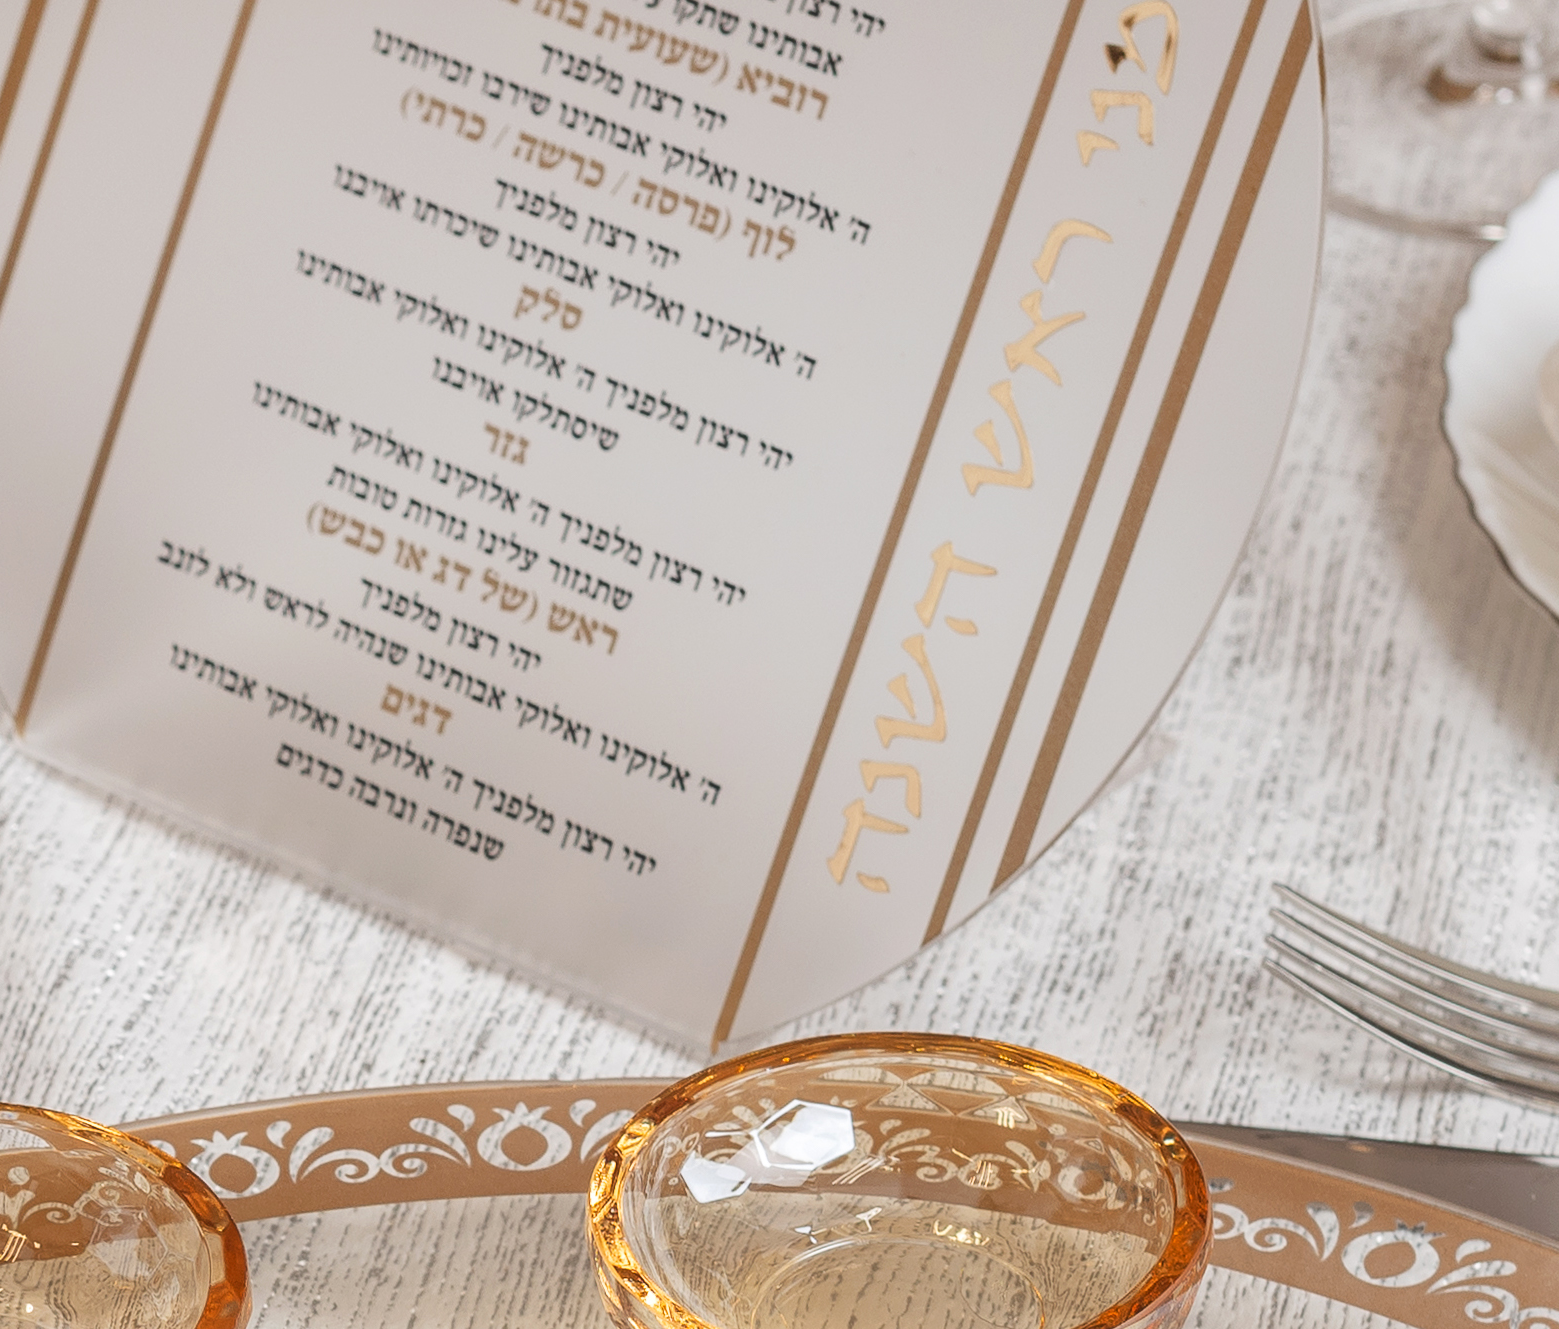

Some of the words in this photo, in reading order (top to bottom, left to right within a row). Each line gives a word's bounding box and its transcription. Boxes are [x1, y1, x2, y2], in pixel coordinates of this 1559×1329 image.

[849, 7, 887, 38] יהי
[373, 28, 475, 86] זכויותינו
[541, 43, 624, 96] מלפניך
[748, 20, 845, 77] אבותינו
[400, 89, 487, 142] כרתי)
[482, 71, 552, 116] שירבו
[630, 79, 684, 118] רצון
[693, 103, 727, 132] יהי
[735, 62, 831, 122] רוביא
[559, 102, 651, 157] אבותינו
[512, 131, 606, 189] כרשה
[660, 141, 738, 192] ואלוקי
[335, 164, 406, 211] אויבנו
[496, 178, 578, 232] מלפניך
[632, 177, 731, 239] (פרסה
[747, 176, 840, 233] אלוקינו
[413, 196, 500, 248] שיכרתו
[584, 215, 637, 254] רצון
[742, 218, 796, 261] לוף
[297, 249, 386, 304] אבותינו
[507, 235, 599, 290] אבותינו
[647, 239, 681, 268] יהי
[395, 289, 469, 339] ואלוקי
[514, 285, 583, 331] סלק
[608, 275, 685, 326] ואלוקי
[477, 324, 567, 380] אלוקינו
[693, 310, 786, 367] אלוקינו
[961, 218, 1113, 497] ראש
[433, 356, 505, 405] אויבנו
[606, 377, 689, 432] מלפניך
[253, 381, 341, 436] אבותינו
[513, 390, 619, 451] שיסתלקו
[350, 422, 424, 472] ואלוקי
[484, 423, 530, 465] גזר
[696, 416, 749, 456] רצון
[759, 440, 793, 470] יהי
[326, 465, 398, 511] טובות
[432, 457, 521, 513] אלוקינו
[307, 502, 386, 556] כבש)
[402, 497, 468, 542] גזרות
[560, 511, 643, 567] מלפניך
[157, 540, 211, 577] לזנב
[394, 538, 428, 573] או
[432, 556, 473, 592] דג
[477, 527, 539, 572] עלינו
[649, 551, 703, 591] רצון
[215, 565, 257, 600] ולא
[264, 586, 330, 629] לראש
[361, 578, 442, 632] מלפניך
[481, 568, 539, 623] (של
[549, 557, 633, 611] שתגזור
[713, 576, 746, 606] יהי
[334, 618, 409, 666] שנהיה
[447, 617, 499, 657] רצון
[547, 602, 619, 655] ראש
[171, 644, 258, 701] אבותינו
[416, 653, 506, 711] אבותינו
[509, 642, 541, 672] יהי
[266, 686, 339, 738] ואלוקי
[380, 684, 453, 735] דגים
[515, 696, 592, 749] ואלוקי
[827, 541, 998, 893] השנה
[275, 743, 344, 790] כדגים
[347, 722, 435, 781] אלוקינו
[600, 733, 691, 792] אלוקינו
[348, 775, 418, 824] ונרבה
[473, 778, 555, 835] מלפניך
[421, 808, 505, 861] שנפרה
[561, 819, 614, 861] רצון
[623, 845, 657, 876] יהי
